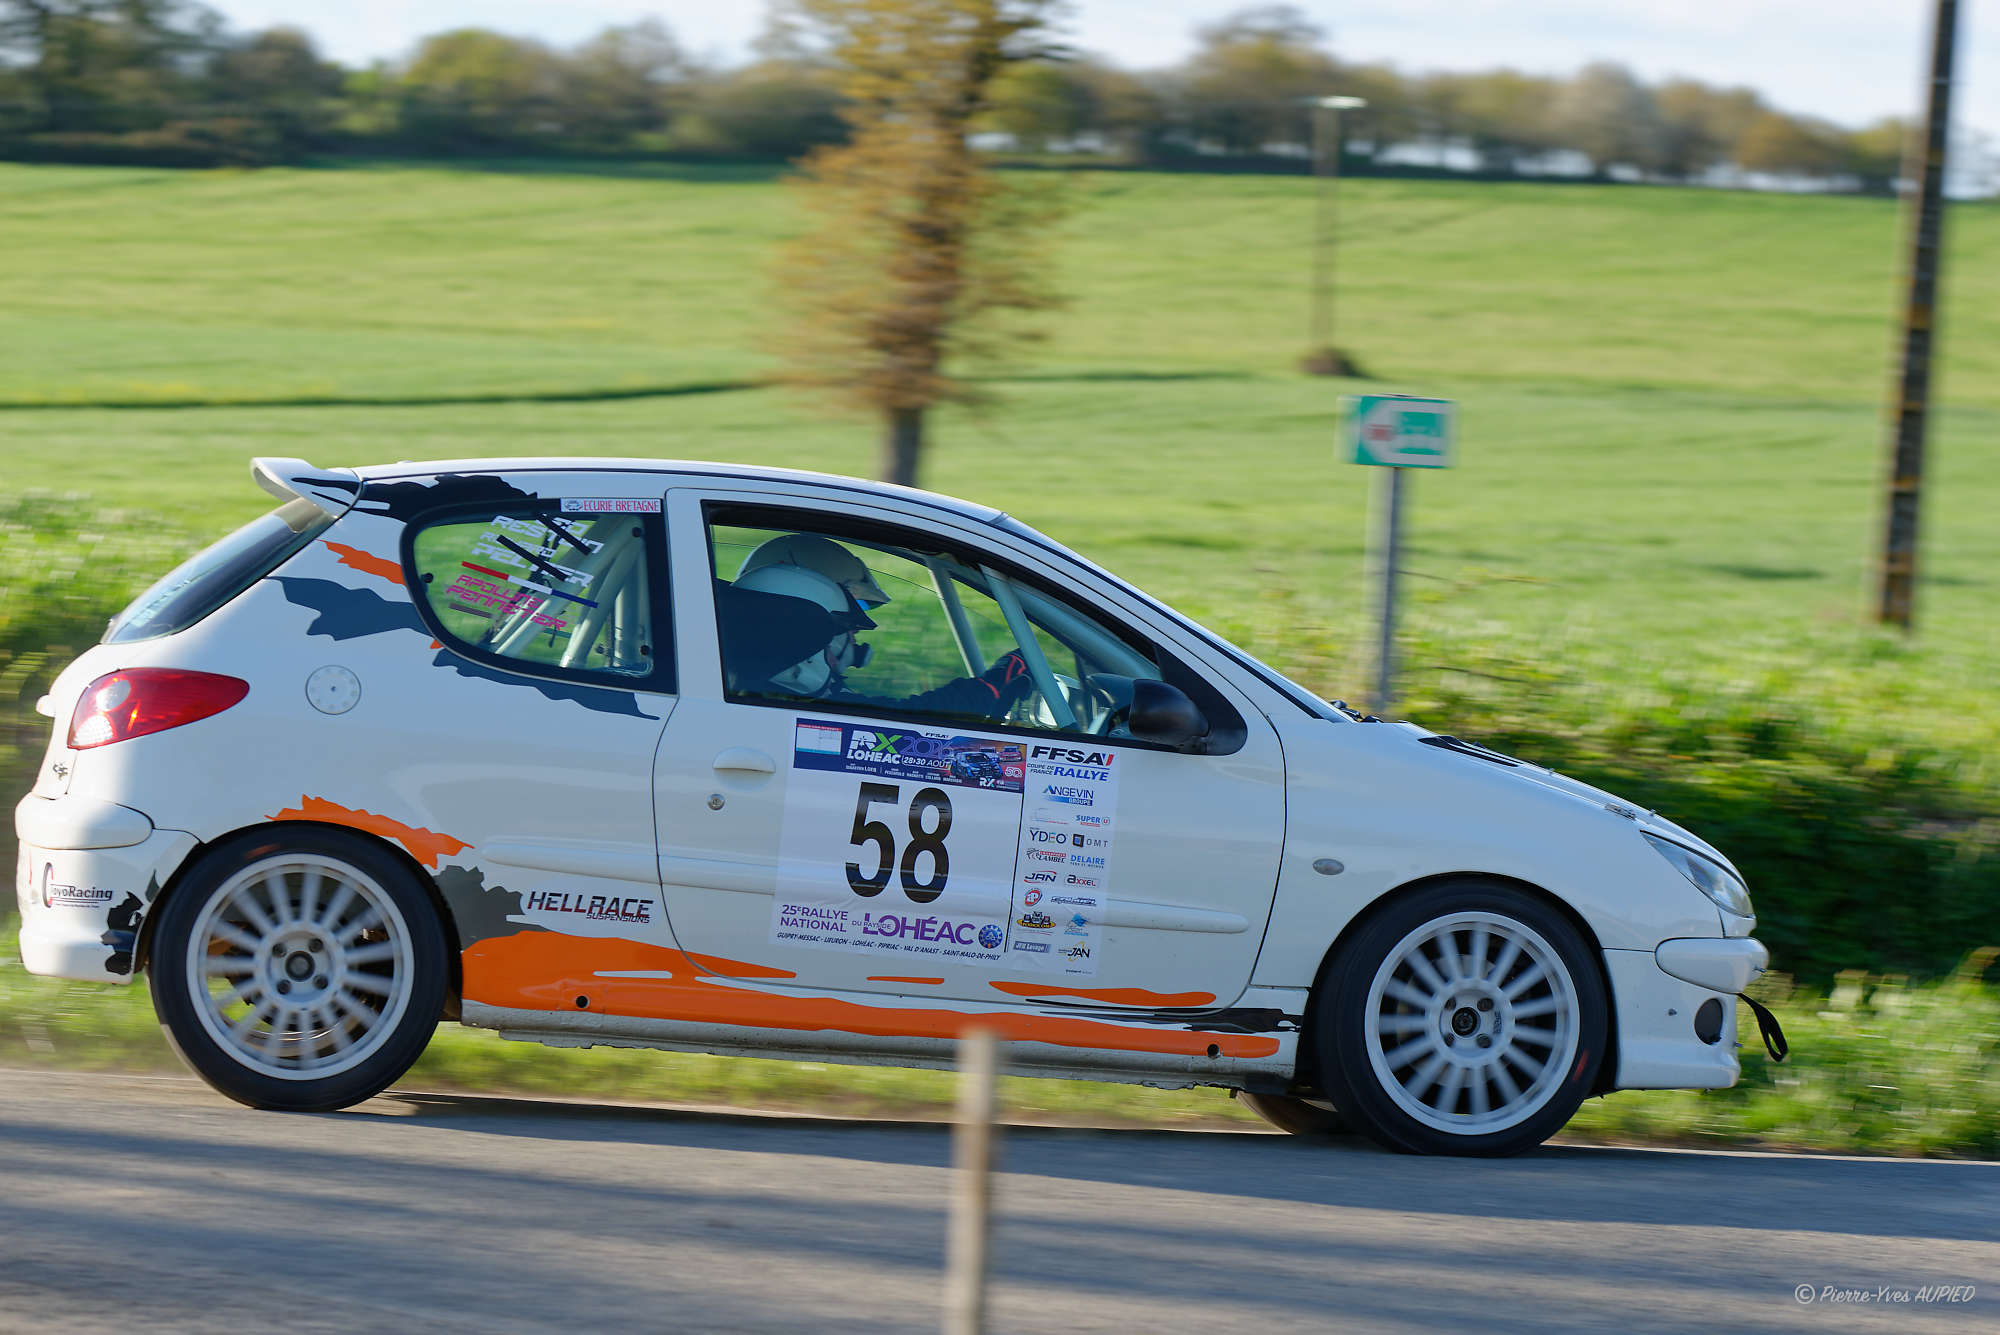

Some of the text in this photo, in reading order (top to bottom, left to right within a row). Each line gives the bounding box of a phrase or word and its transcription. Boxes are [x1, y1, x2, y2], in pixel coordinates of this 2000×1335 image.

[583, 499, 660, 512] ECURIE BRETAGNE
[846, 750, 902, 765] LOHEAC
[1031, 745, 1104, 766] FFSA
[1053, 766, 1109, 781] RALLYE
[1042, 784, 1094, 799] ANGEVIN
[1076, 814, 1101, 824] SUPER
[845, 781, 953, 904] 58
[1030, 830, 1067, 844] YDEO
[1070, 854, 1105, 865] DELAIRE
[1024, 872, 1056, 882] JAN
[527, 890, 654, 918] HELLRACE
[586, 912, 651, 924] SUSPENSIONS
[801, 906, 848, 920] RALLYE
[780, 916, 847, 933] NATIONAL
[863, 912, 976, 945] LOHÉAC
[877, 942, 900, 951] PIPRIAC
[1067, 947, 1091, 958] JAN
